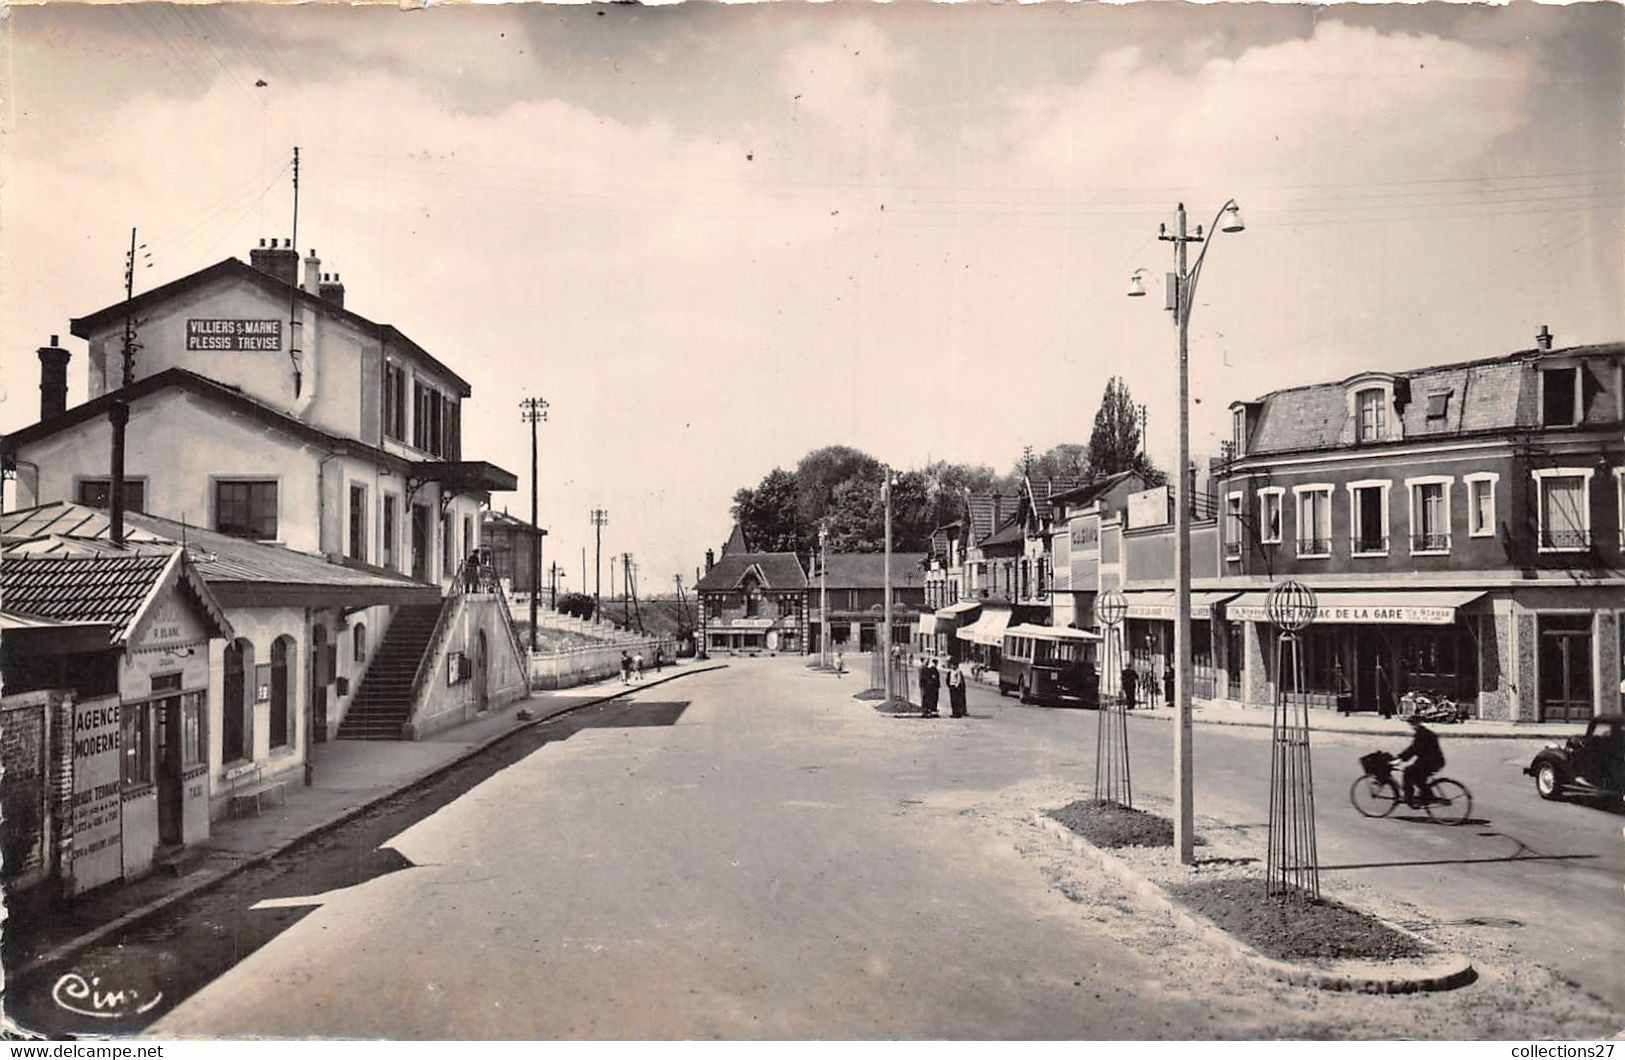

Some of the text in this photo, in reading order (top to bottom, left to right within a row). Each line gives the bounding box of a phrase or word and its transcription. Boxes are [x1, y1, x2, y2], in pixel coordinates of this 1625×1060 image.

[190, 321, 235, 334] VILLIERS
[245, 321, 279, 334] MARNE
[190, 337, 279, 349] PLESSIS TREVISE
[1336, 609, 1349, 619] DE
[1354, 609, 1369, 619] LA
[1374, 609, 1403, 619] GARE
[76, 706, 119, 732] AGENCE
[74, 730, 119, 759] MODERNE
